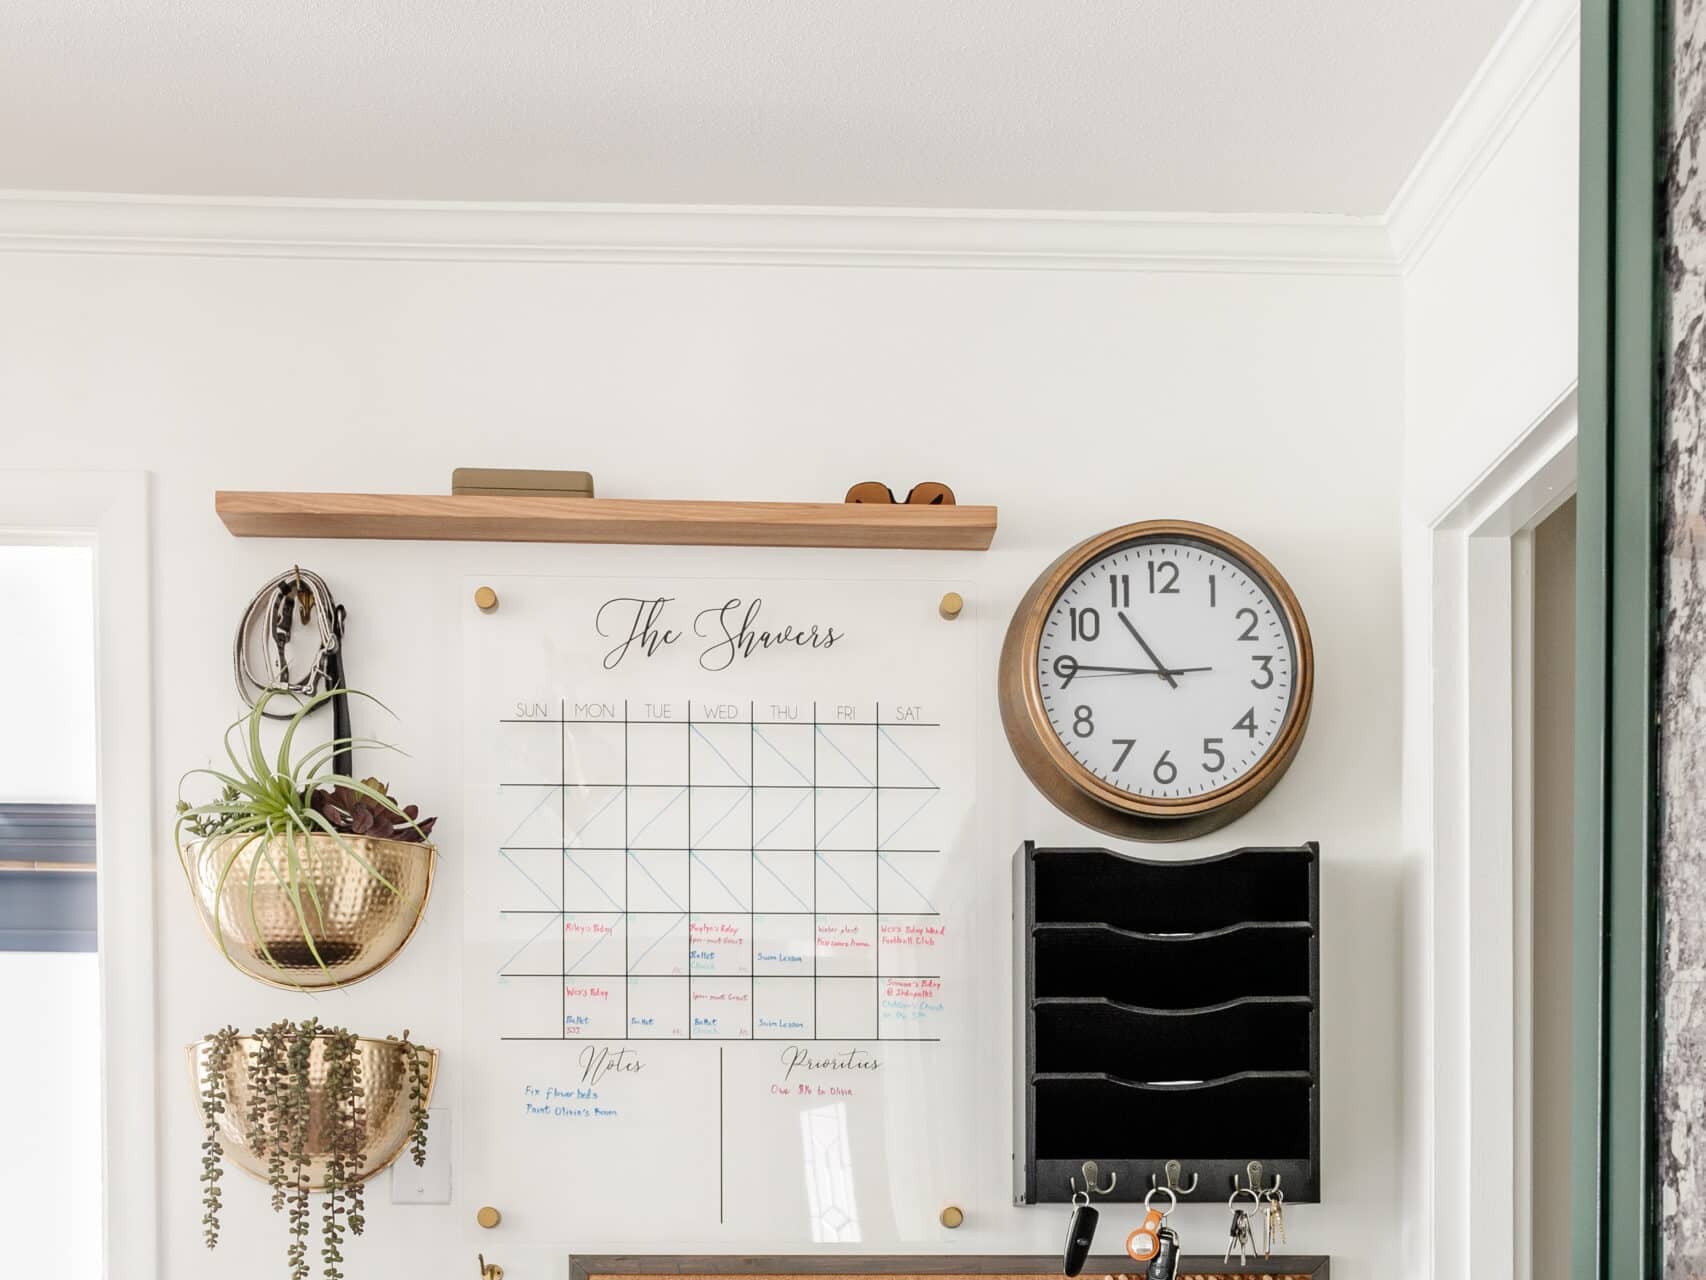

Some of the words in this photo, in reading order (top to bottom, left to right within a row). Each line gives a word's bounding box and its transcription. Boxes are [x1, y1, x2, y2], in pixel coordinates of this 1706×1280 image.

[1110, 573, 1130, 608] 11
[1148, 560, 1180, 594] 12
[1208, 574, 1217, 608] 1
[595, 597, 682, 670] The
[693, 598, 844, 672] Shavers
[1069, 607, 1100, 642] 10
[1235, 608, 1260, 641] 2
[1053, 654, 1079, 690] 9
[1250, 655, 1274, 690] 3
[515, 703, 548, 718] SUN
[574, 704, 615, 719] MON
[645, 704, 672, 719] TUE
[703, 705, 739, 720] WED
[770, 705, 798, 720] THU
[837, 706, 856, 721] FRI
[895, 706, 921, 721] SAT
[1072, 704, 1095, 739] 8
[1232, 706, 1259, 739] 4
[1111, 739, 1137, 773] 7
[1153, 750, 1178, 785] 6
[1201, 738, 1226, 774] 5
[579, 1045, 645, 1087] Notes
[781, 1045, 882, 1080] Priorities
[525, 1085, 540, 1096] Fix
